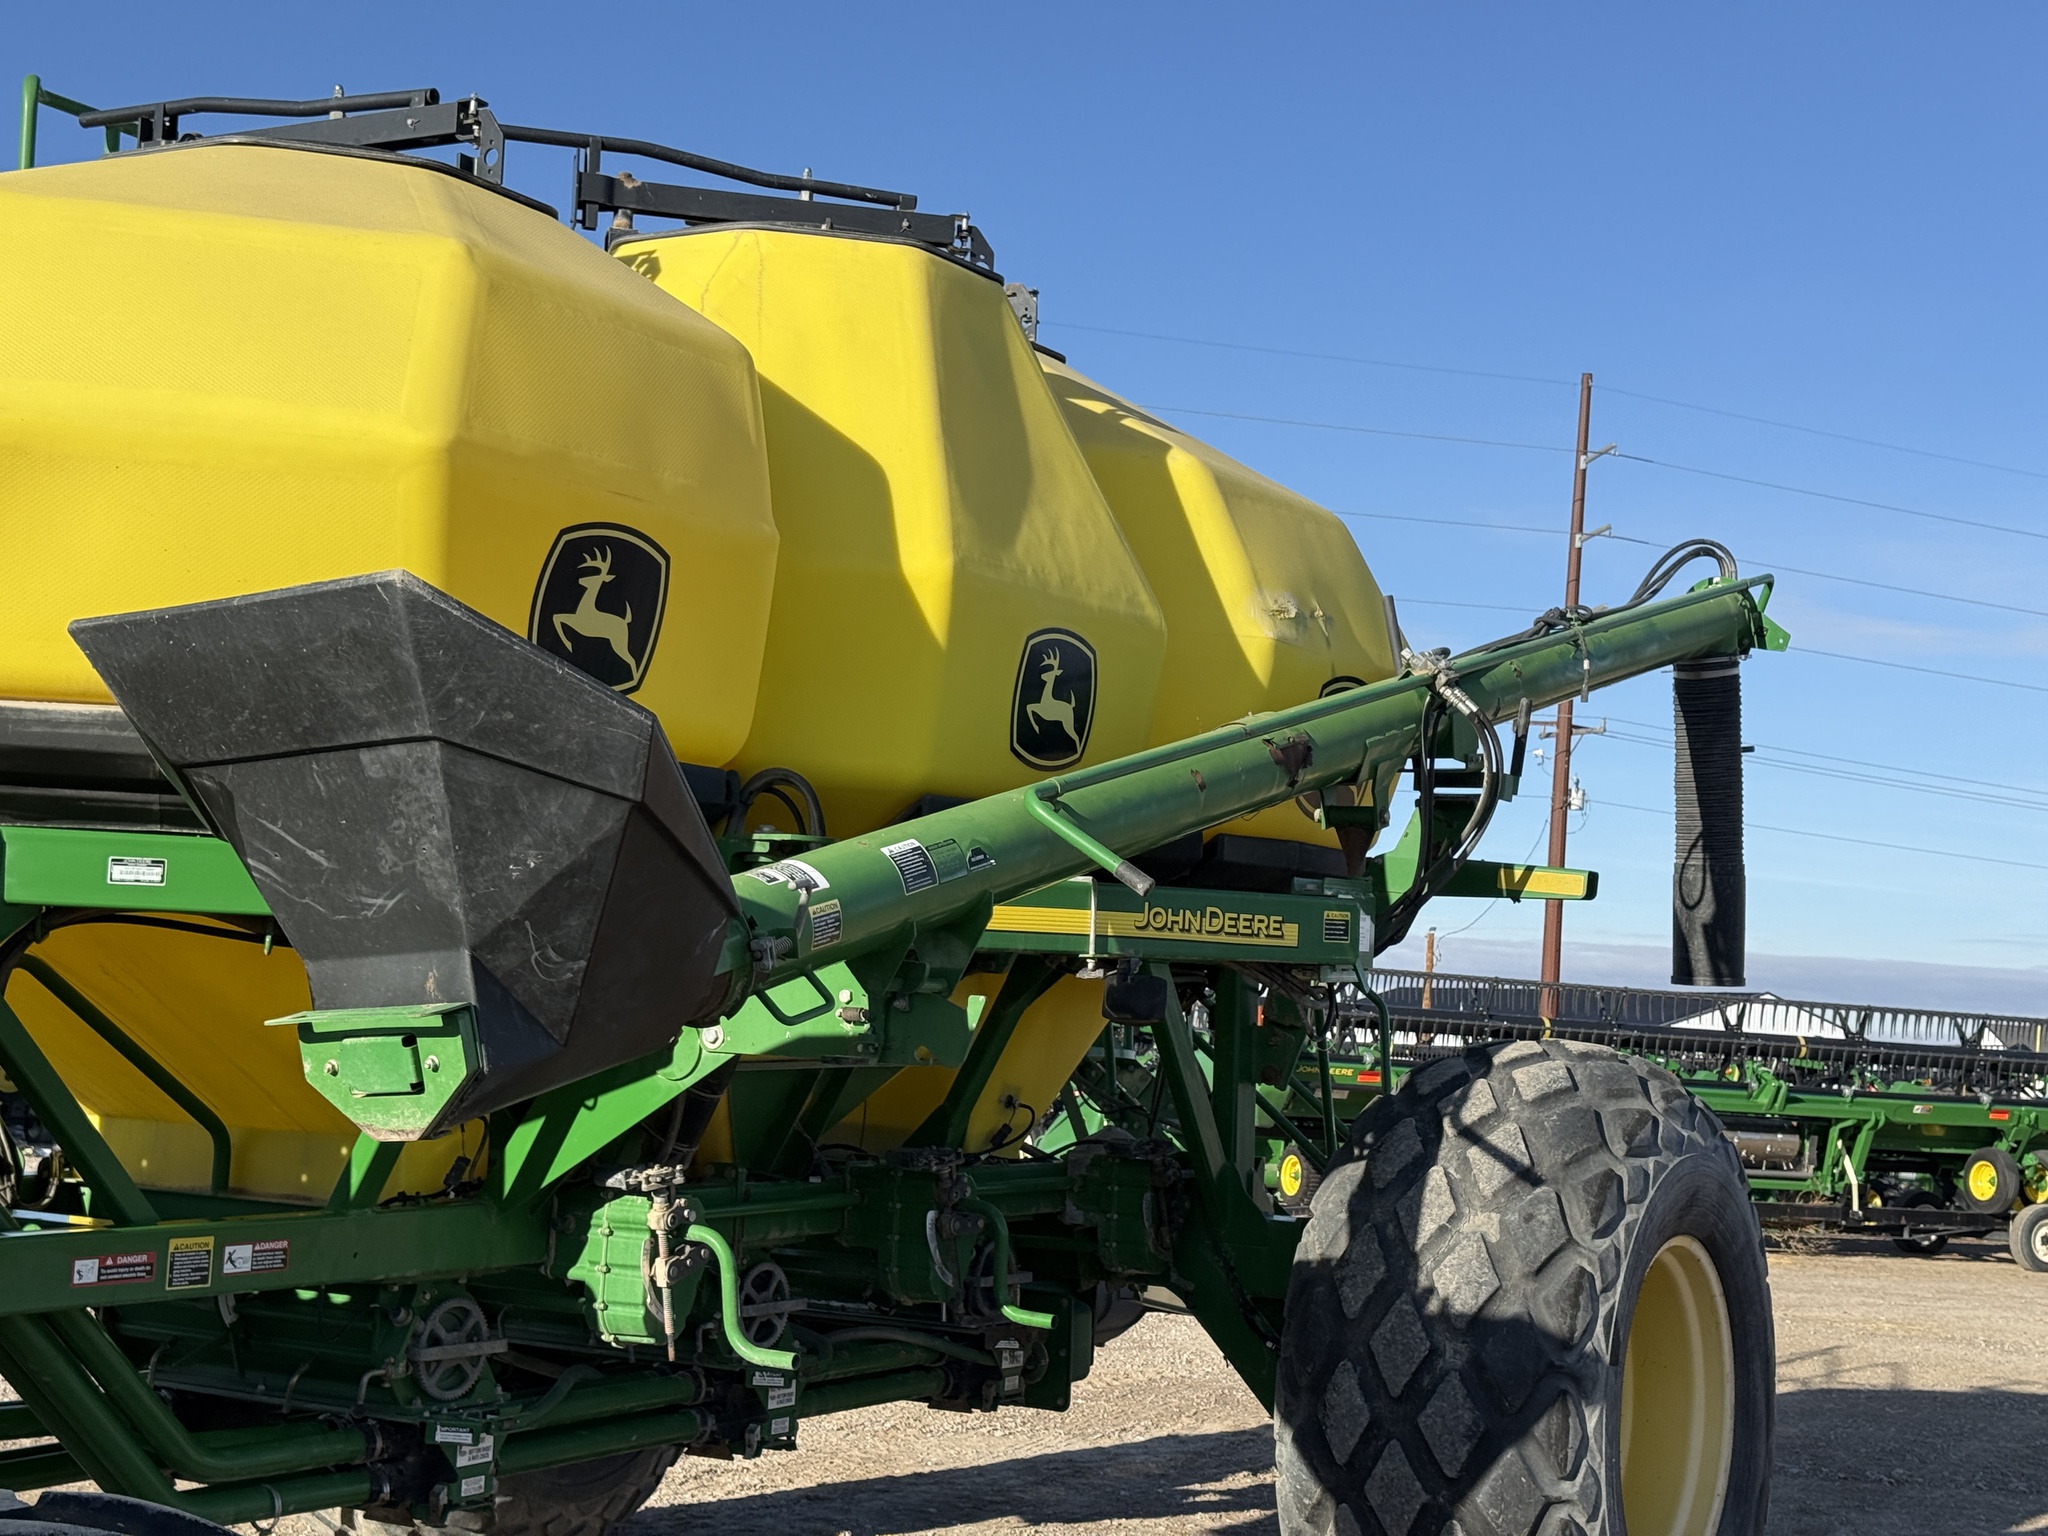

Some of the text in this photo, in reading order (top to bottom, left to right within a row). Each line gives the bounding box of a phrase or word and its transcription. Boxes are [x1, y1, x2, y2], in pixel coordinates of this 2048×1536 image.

[894, 842, 917, 853] CAUTION
[815, 902, 839, 914] CAUTION
[1134, 901, 1285, 938] JOHN DEERE
[1296, 1065, 1354, 1076] JOHN EERE
[180, 1241, 210, 1250] CAUTION
[259, 1240, 288, 1250] DANGER
[117, 1254, 148, 1264] DANGER
